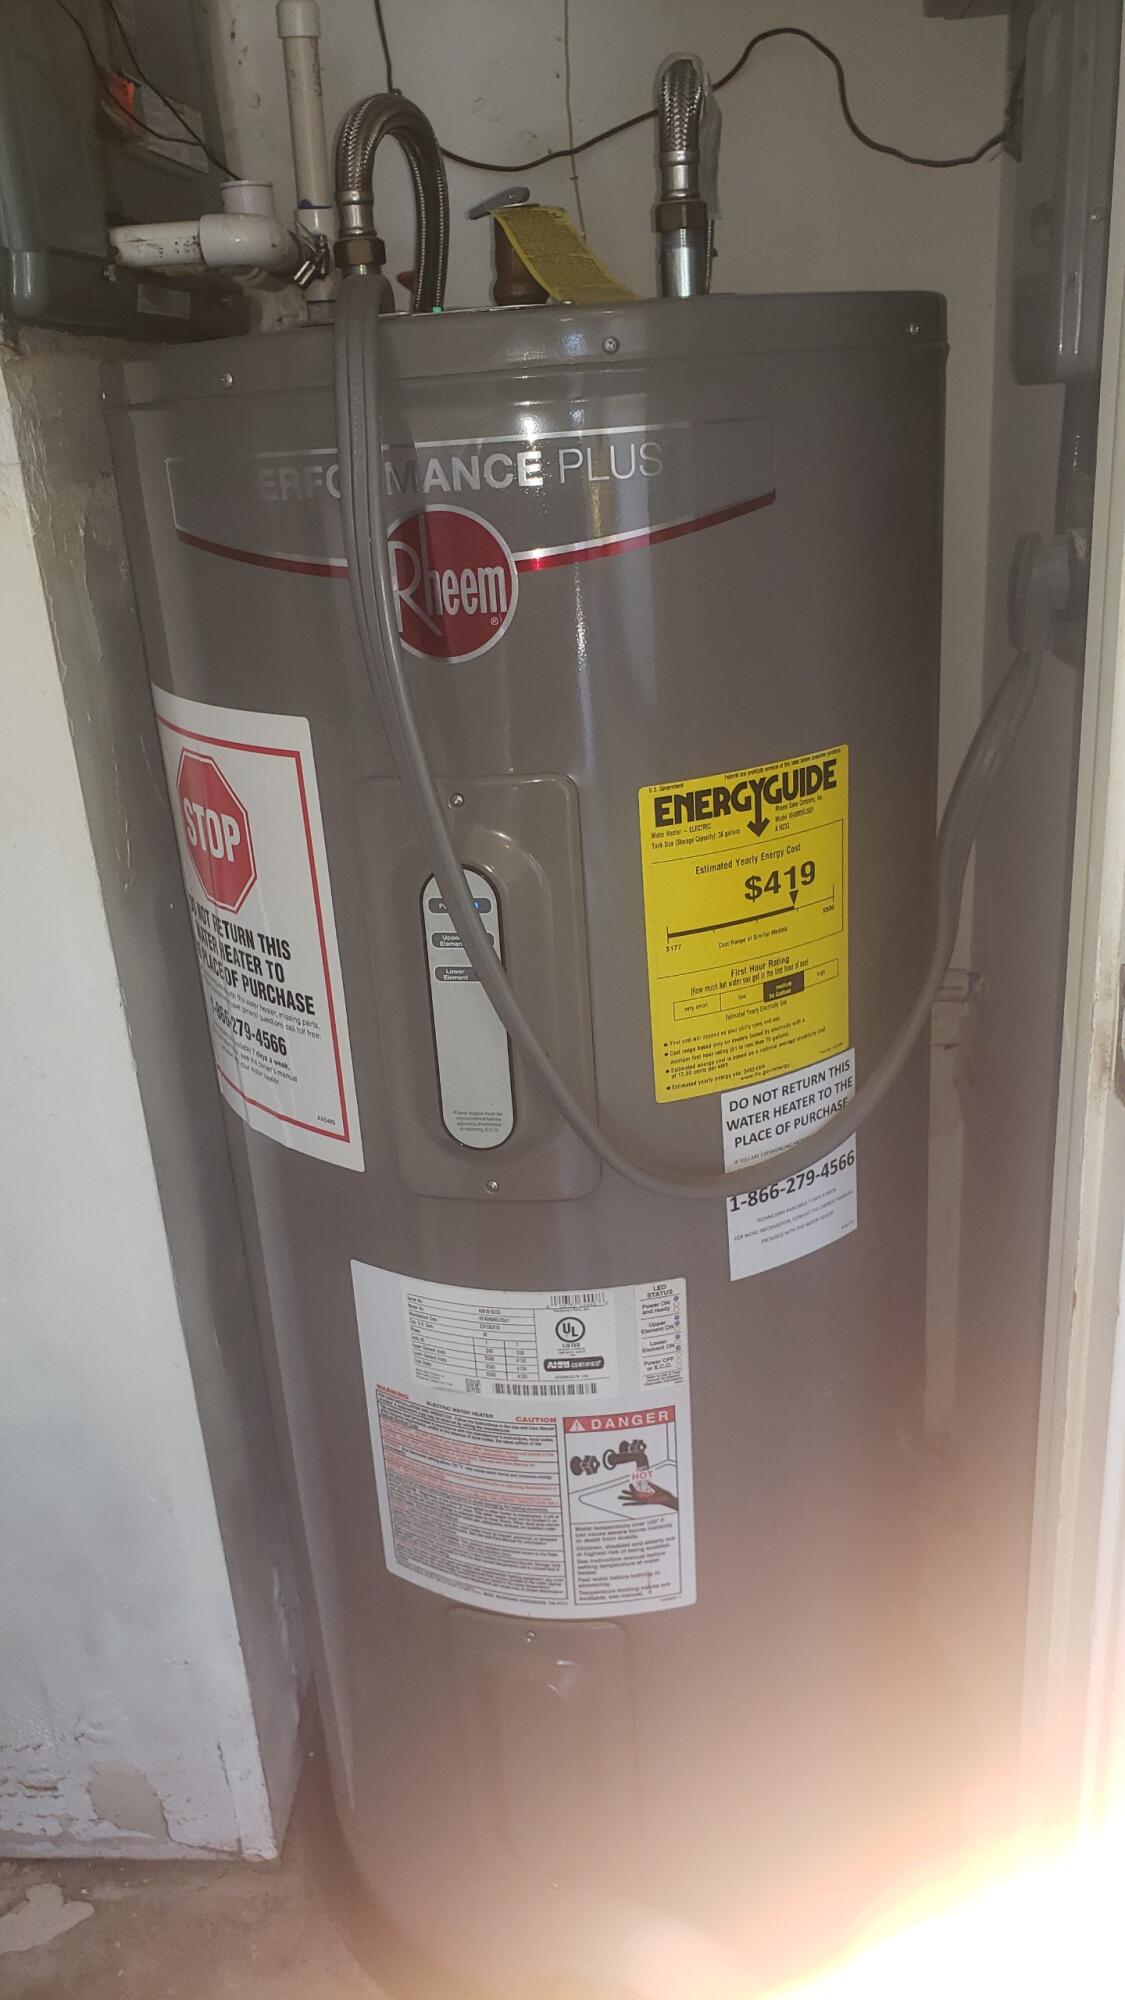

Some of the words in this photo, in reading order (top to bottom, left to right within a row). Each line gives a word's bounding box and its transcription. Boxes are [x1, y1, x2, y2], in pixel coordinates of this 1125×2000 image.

[559, 440, 664, 484] PLUS
[390, 514, 509, 637] Rheem
[654, 758, 838, 829] ENERGYGUIDE
[183, 797, 241, 863] STOP
[695, 860, 733, 875] Estimated
[735, 854, 759, 869] Yearly
[761, 847, 784, 864] Energy
[786, 843, 801, 855] Cost
[744, 860, 816, 903] $419
[196, 901, 210, 928] NOT
[211, 913, 255, 950] RETURN
[257, 933, 291, 961] THIS
[665, 943, 682, 952] $177
[218, 940, 263, 976] HEATER
[265, 960, 285, 983] TO
[730, 966, 747, 977] First
[750, 962, 766, 972] Hour
[768, 956, 790, 967] Rating
[224, 967, 239, 988] OF
[241, 974, 316, 1016] PURCHASE
[210, 996, 288, 1056] 1-866-279-4566
[726, 1110, 770, 1131] WATER
[773, 1094, 816, 1118] HEATER
[818, 1086, 832, 1101] TO
[834, 1076, 853, 1093] THE
[729, 1098, 749, 1112] DO
[753, 1088, 779, 1106] NOT
[781, 1073, 826, 1097] RETURN
[828, 1059, 851, 1078] THIS
[734, 1128, 772, 1148] PLACE
[775, 1121, 792, 1136] OF
[794, 1097, 848, 1129] PURCHASE
[729, 1150, 855, 1212] 1-866-279-4566
[647, 1289, 673, 1299] STATUS
[562, 1322, 579, 1337] UL
[426, 1401, 451, 1411] ELECTRIC
[471, 1411, 494, 1419] HEATER
[591, 1410, 669, 1430] DANGER
[631, 1470, 653, 1480] HOT
